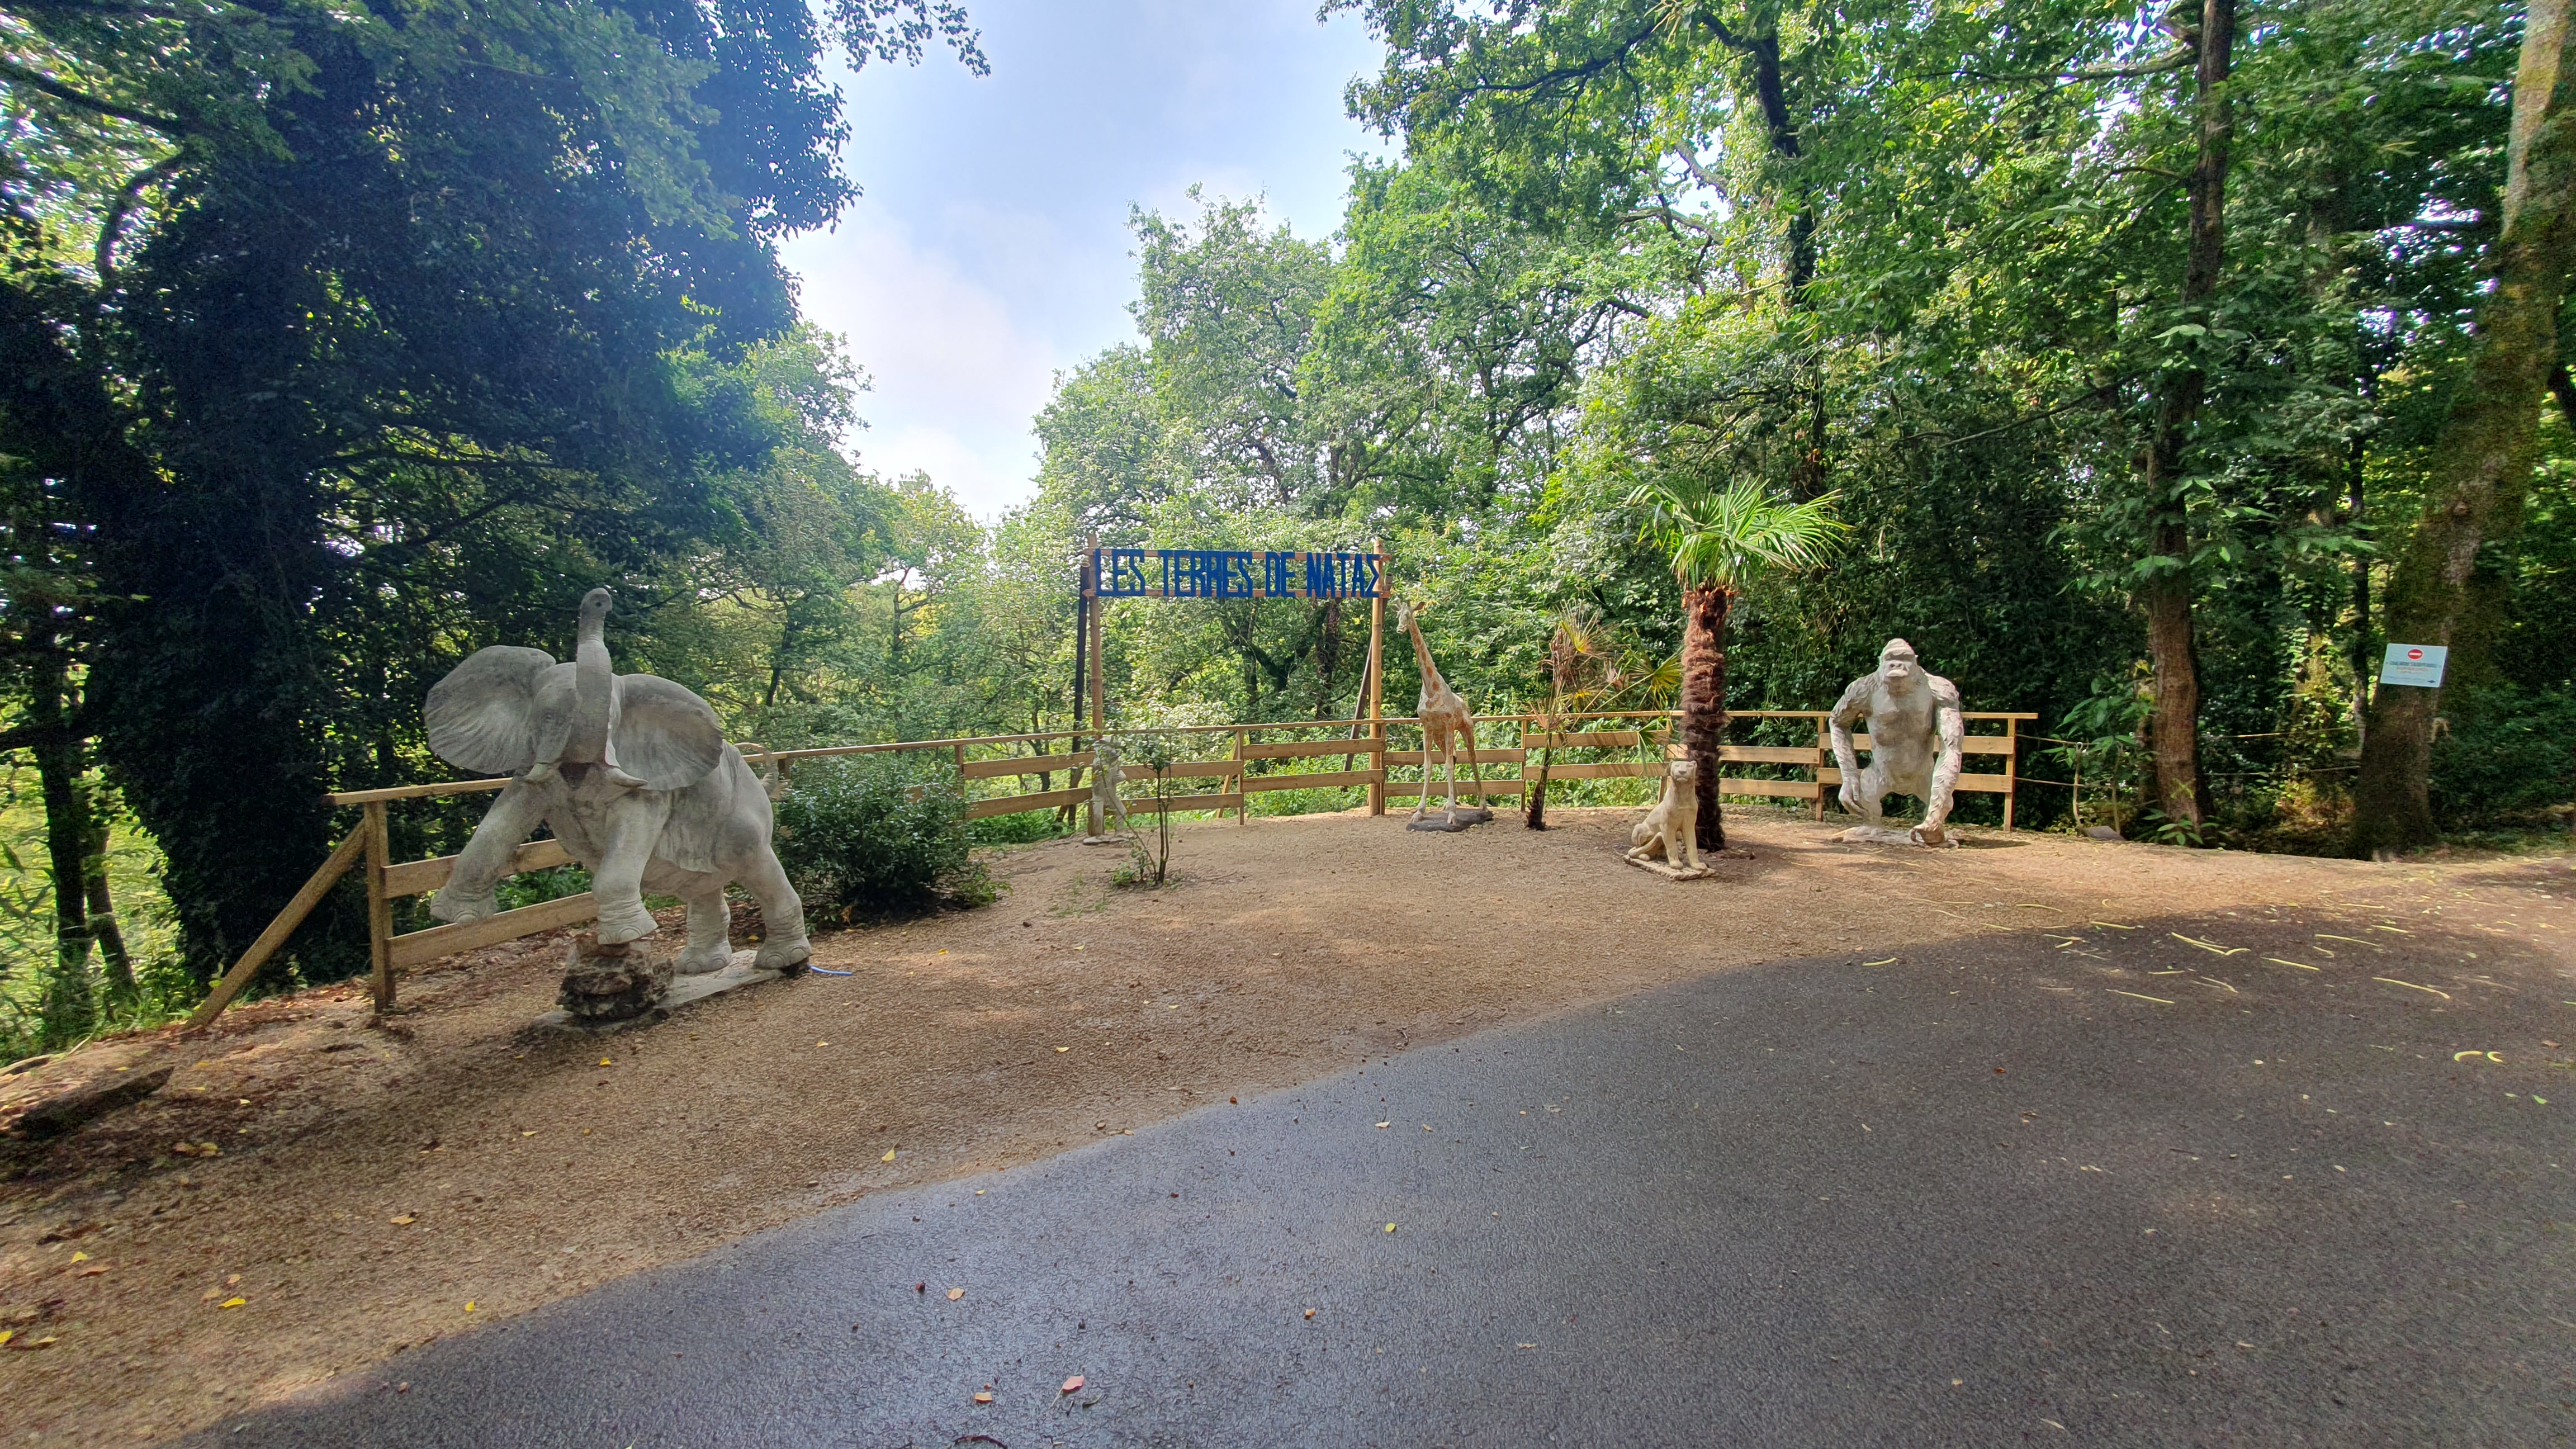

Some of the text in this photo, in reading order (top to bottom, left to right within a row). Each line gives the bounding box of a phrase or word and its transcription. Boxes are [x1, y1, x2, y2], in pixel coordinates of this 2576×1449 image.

[1096, 548, 1145, 596] LES
[1157, 550, 1253, 598] TERRES
[1266, 551, 1295, 598] DE
